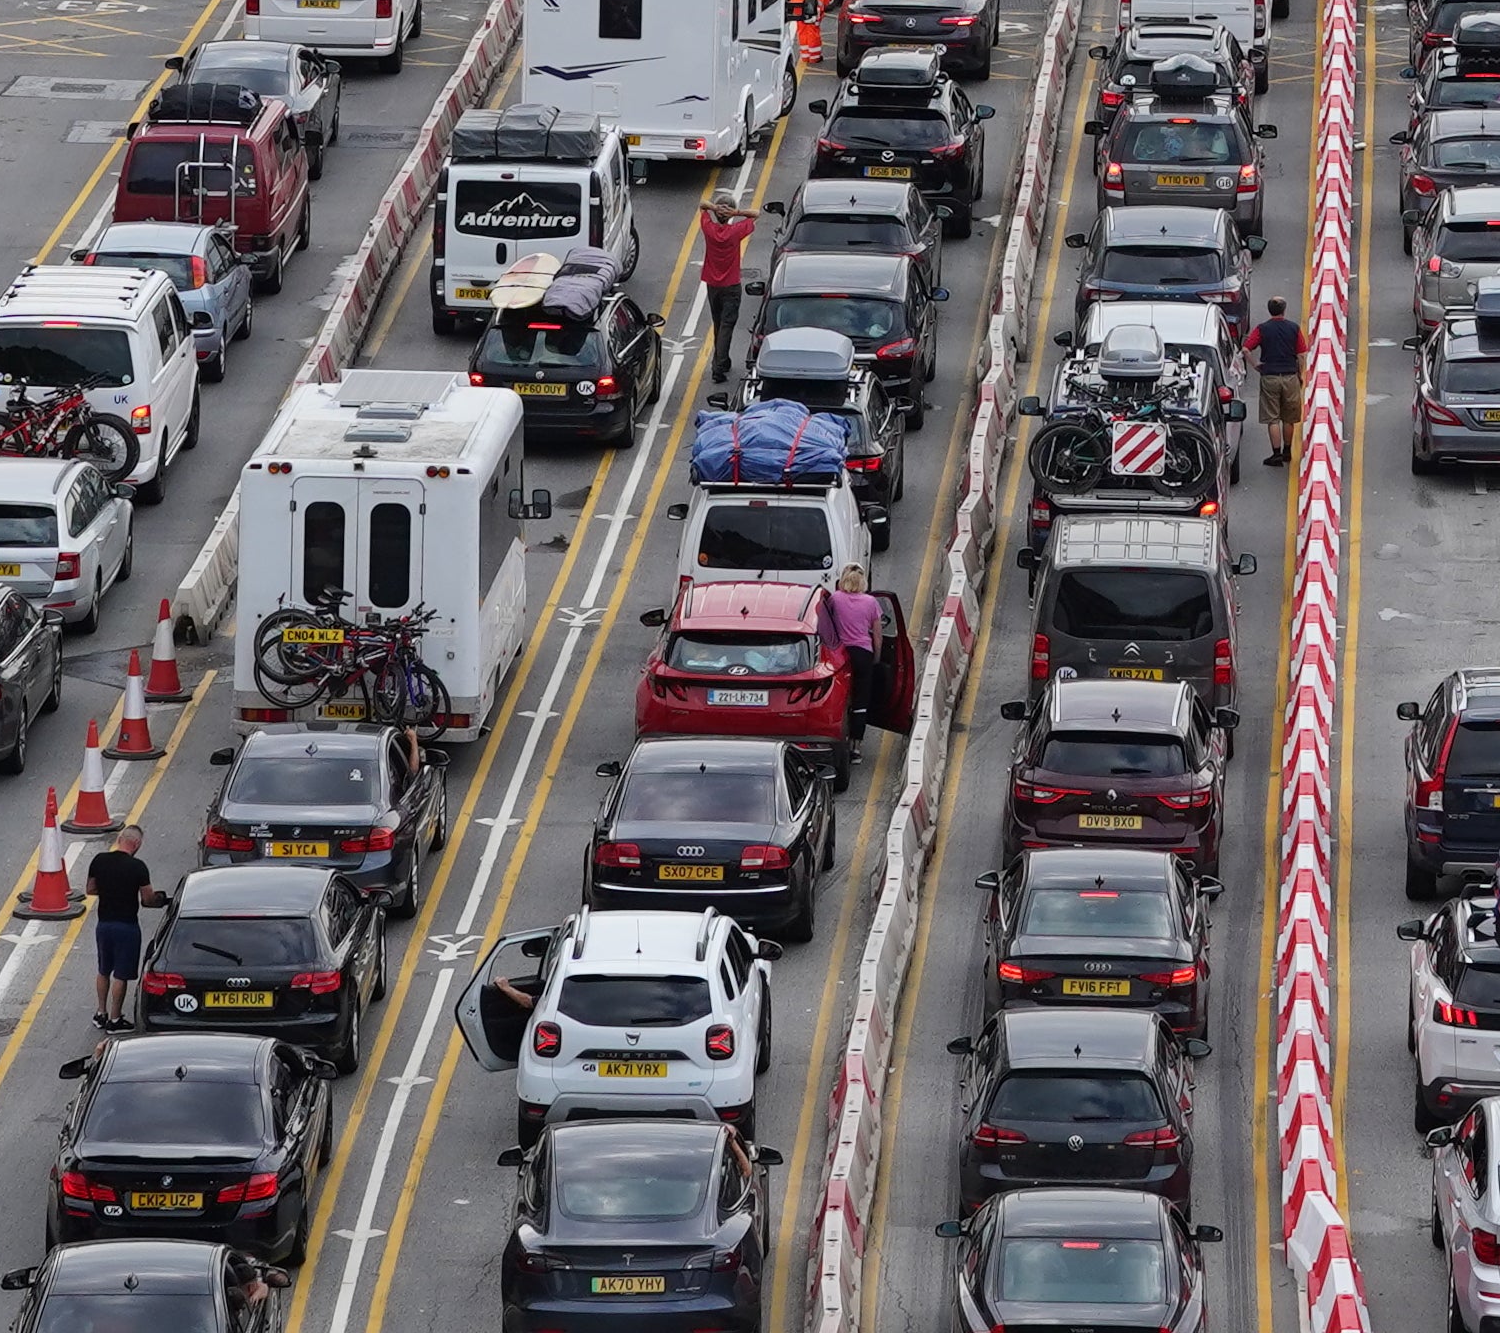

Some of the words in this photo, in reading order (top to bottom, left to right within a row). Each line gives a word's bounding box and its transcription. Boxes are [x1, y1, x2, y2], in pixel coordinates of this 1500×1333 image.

[1218, 178, 1232, 188] GB
[460, 210, 578, 229] Adventure
[517, 384, 542, 395] YF60
[543, 384, 564, 395] OUY
[579, 384, 593, 393] UK
[114, 395, 128, 404] UK
[286, 630, 315, 642] CN04
[1109, 668, 1134, 680] KW19
[1135, 669, 1156, 681] ZYA
[717, 691, 764, 703] 221-LH-734
[327, 705, 356, 717] CN04
[1086, 816, 1112, 827] DV19
[1113, 816, 1135, 828] BXO
[282, 844, 293, 856] S1
[293, 844, 318, 857] YCA
[663, 867, 694, 879] SX07
[695, 868, 718, 880] CPE
[1069, 980, 1095, 993] FV16
[1097, 981, 1122, 994] FFT
[177, 995, 195, 1011] UK
[582, 1064, 596, 1073] GB
[606, 1062, 634, 1076] AK71
[636, 1062, 661, 1076] YRX
[137, 1194, 167, 1208] CK12
[170, 1194, 196, 1208] UZP
[104, 1207, 122, 1217] UK
[600, 1277, 633, 1292] AK70
[635, 1276, 664, 1292] YHY
